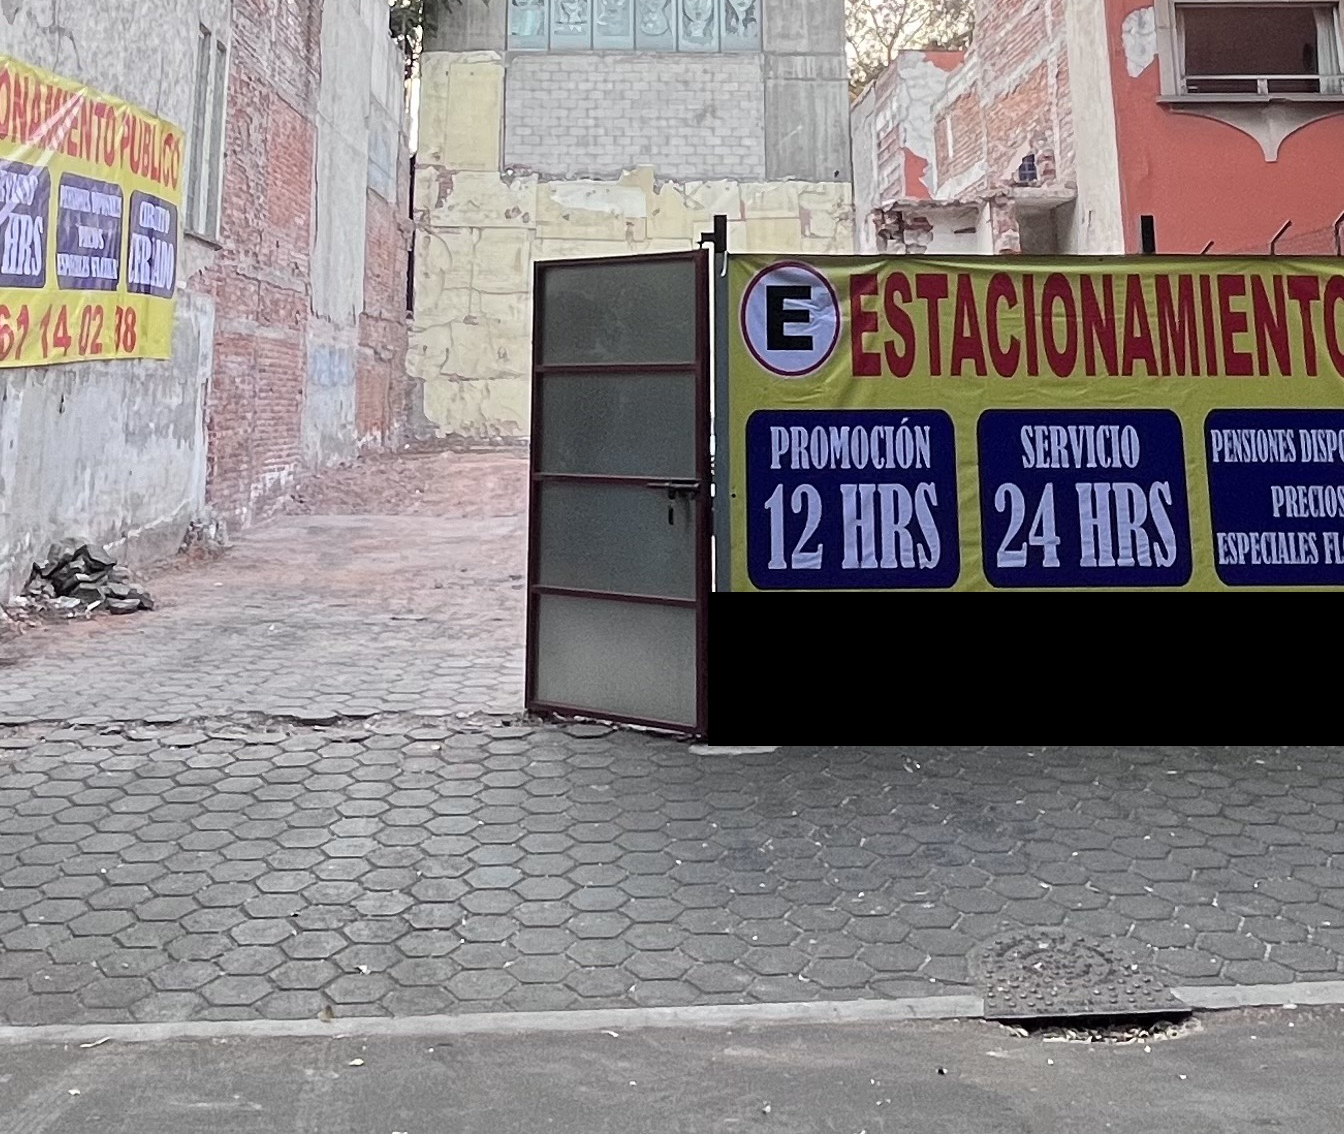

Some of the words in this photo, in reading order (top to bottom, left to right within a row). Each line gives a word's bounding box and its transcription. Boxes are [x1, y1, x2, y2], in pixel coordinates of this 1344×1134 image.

[1, 212, 44, 277] HRS
[40, 303, 72, 359] 14
[78, 304, 104, 356] 02
[765, 284, 814, 351] E
[769, 416, 932, 470] PROMOCIÓN
[1020, 424, 1141, 469] SERVICIO
[1209, 428, 1297, 464] PENSIONES
[764, 482, 824, 570] 12
[840, 481, 941, 570] HRS
[994, 481, 1061, 568] 24
[1075, 481, 1177, 568] HRS
[1217, 531, 1319, 566] ESPECIALES
